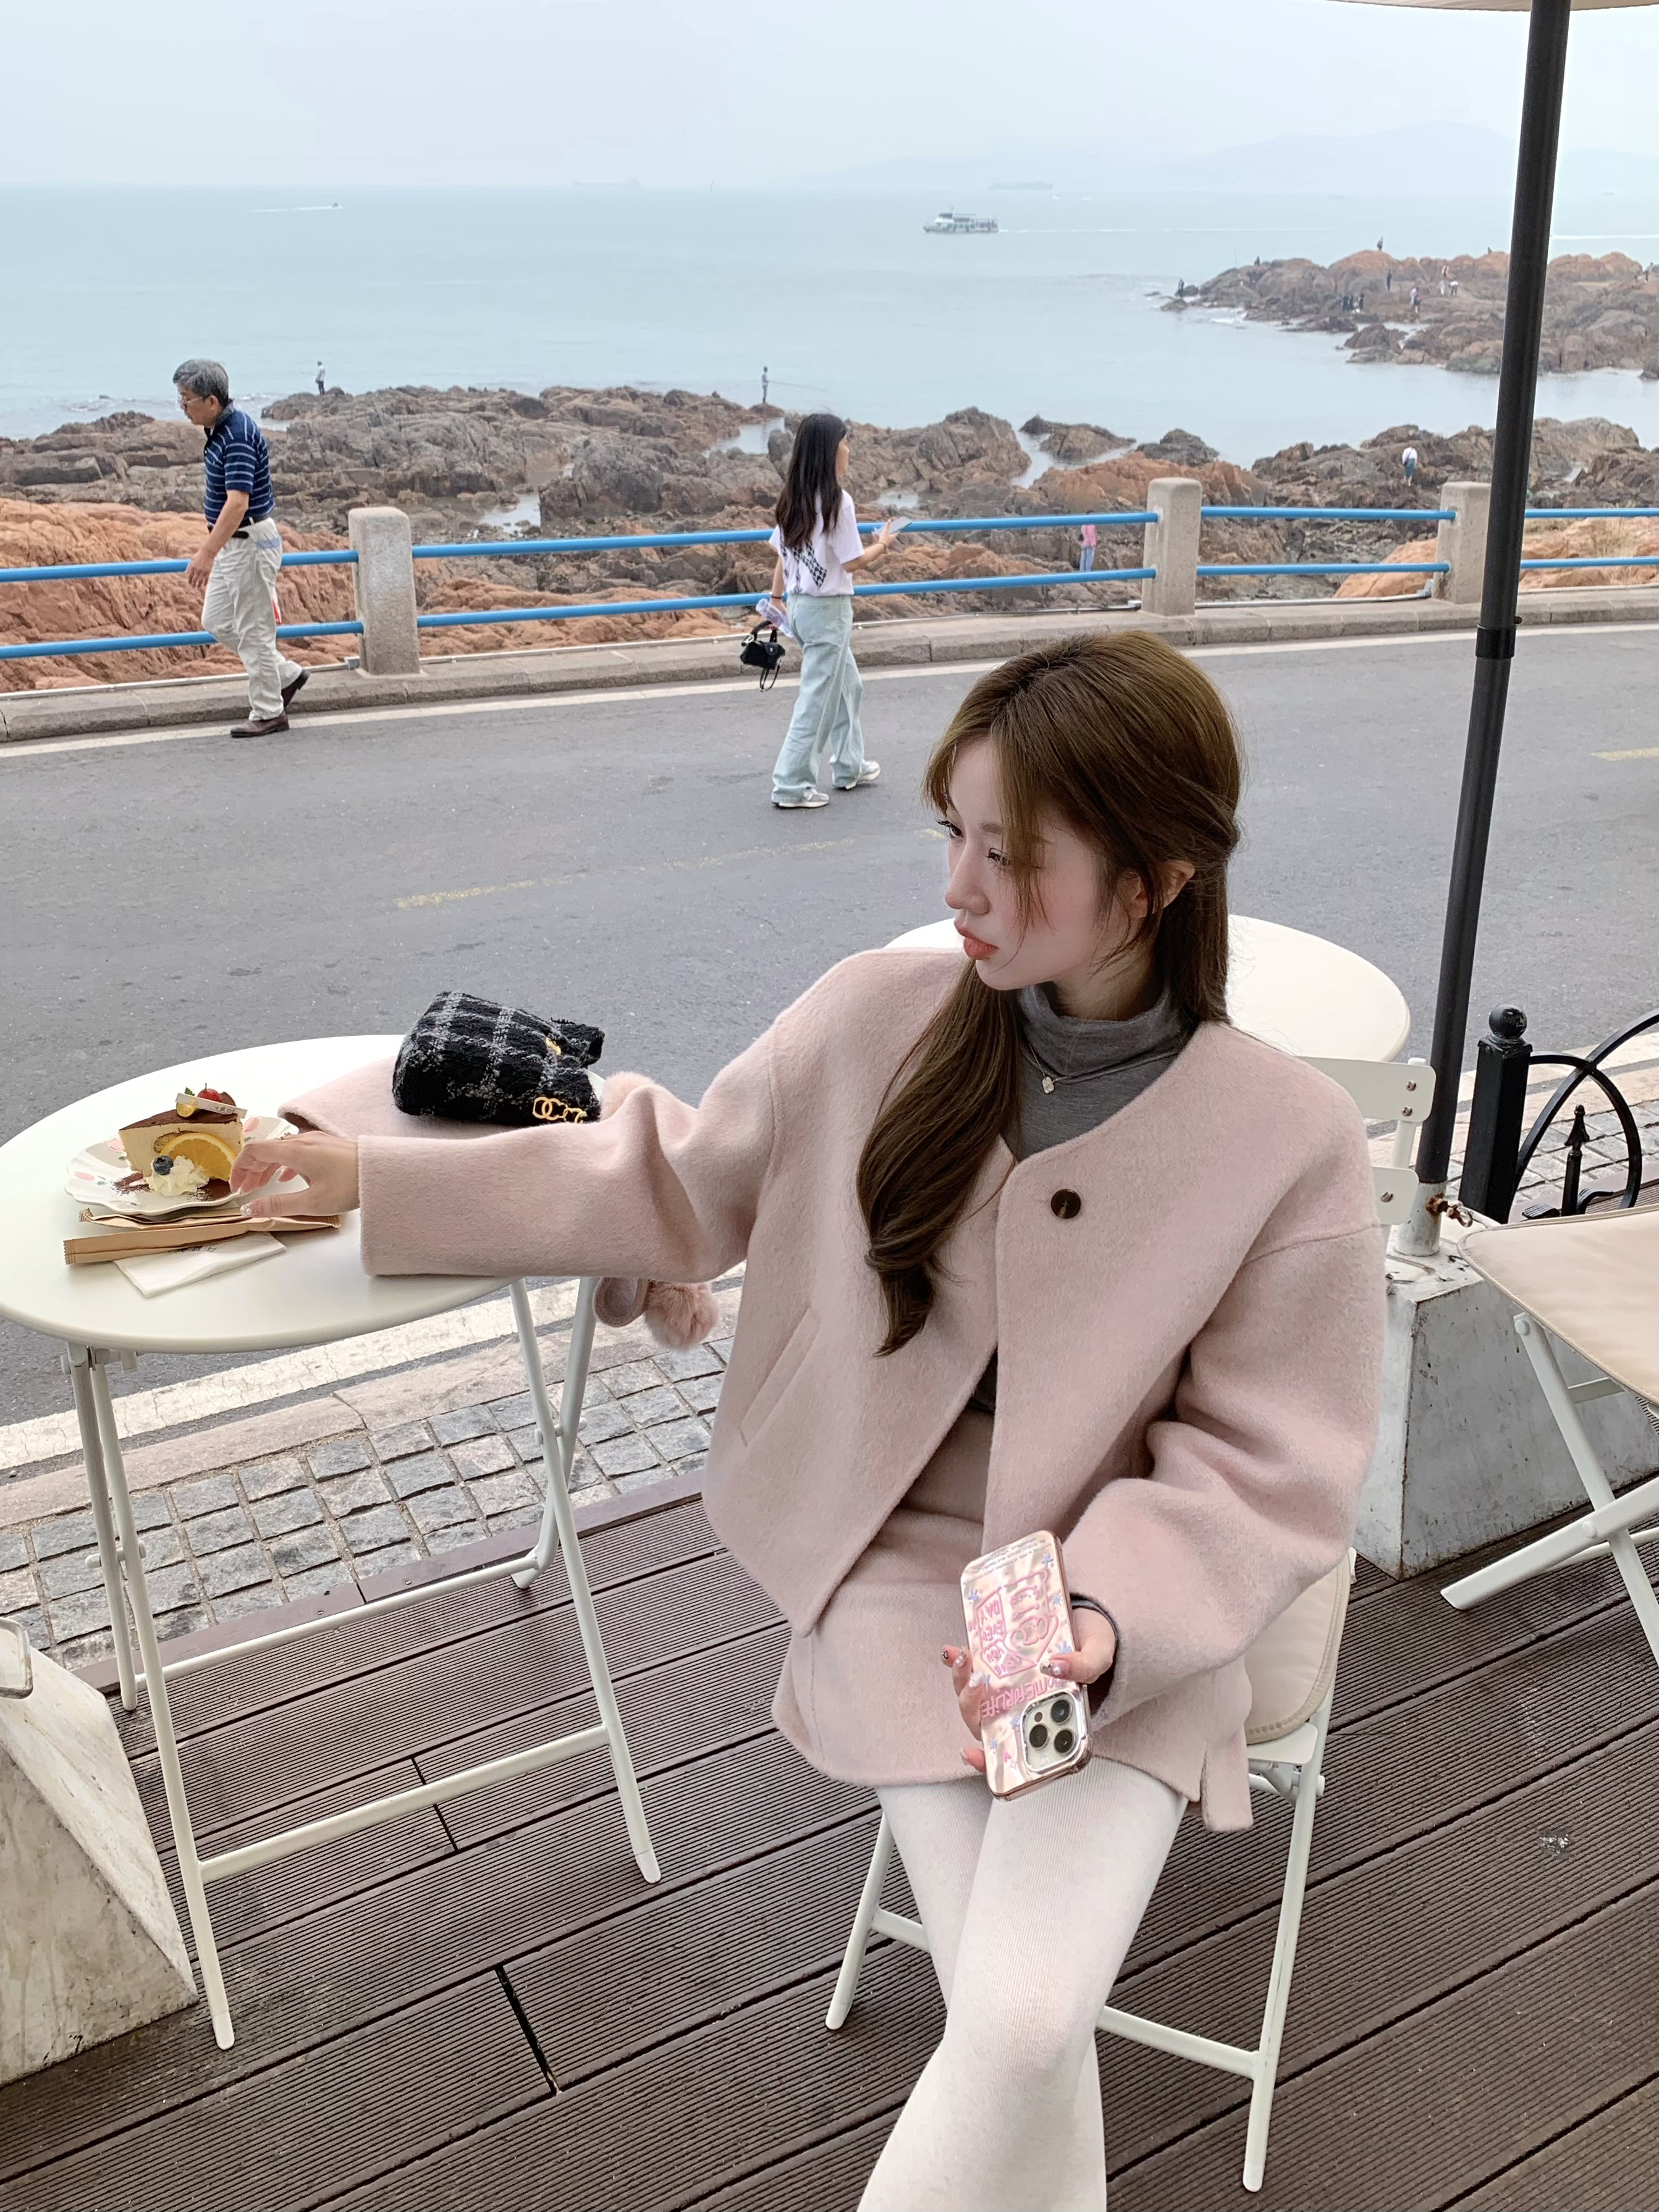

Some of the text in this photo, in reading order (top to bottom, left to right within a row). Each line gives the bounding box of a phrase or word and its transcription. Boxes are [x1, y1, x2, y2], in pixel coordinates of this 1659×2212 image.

[981, 1599, 1000, 1625] DAY
[986, 1645, 1005, 1663] YOU
[994, 1655, 1022, 1675] LOVE
